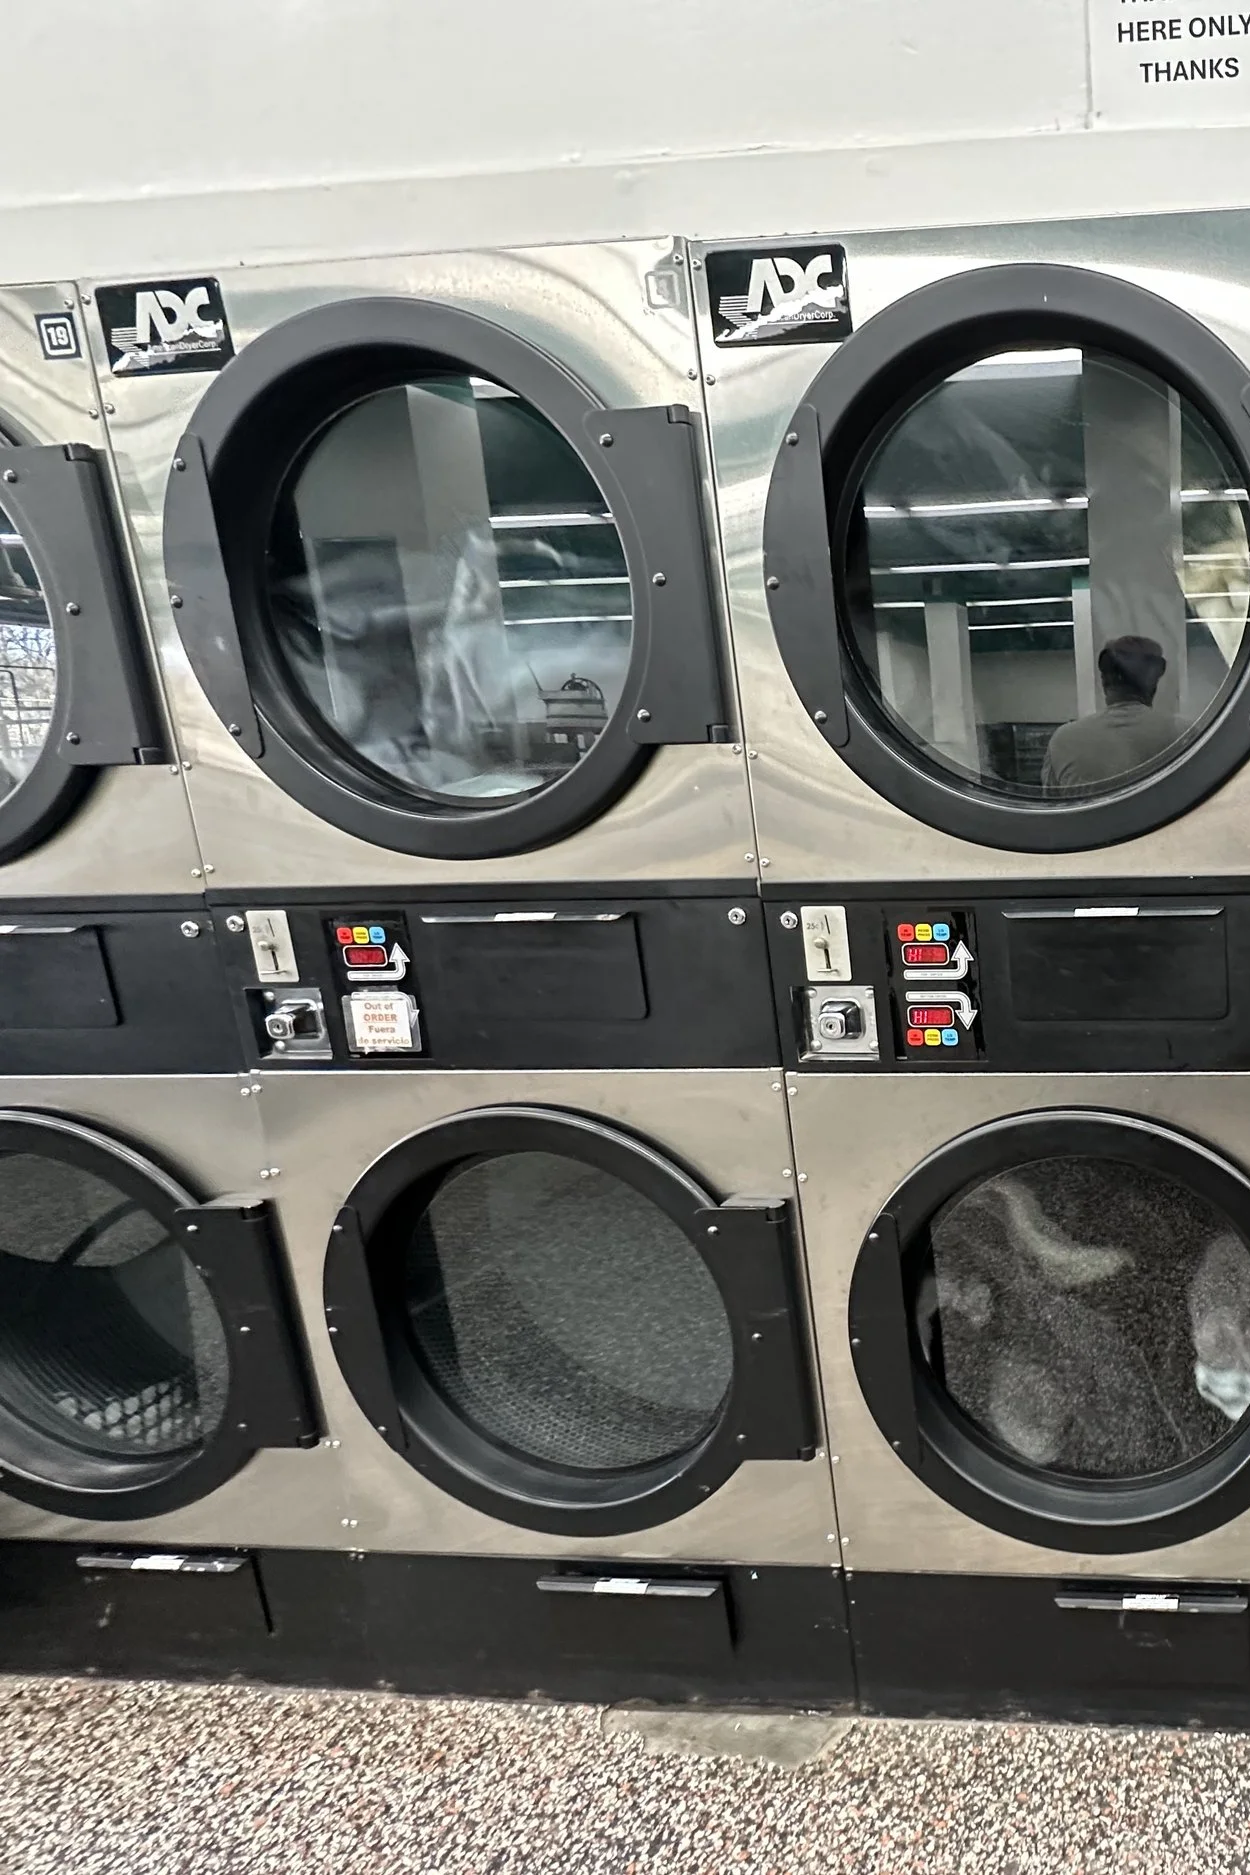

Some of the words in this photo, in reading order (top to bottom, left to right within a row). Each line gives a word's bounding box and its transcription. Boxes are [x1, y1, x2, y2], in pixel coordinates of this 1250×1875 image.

[1118, 18, 1182, 43] HERE
[1139, 57, 1240, 83] THANKS
[746, 253, 837, 313] ADC
[136, 286, 210, 344] ADC
[47, 326, 69, 346] 19
[364, 1002, 381, 1010] Out
[384, 1002, 394, 1010] of
[363, 1013, 398, 1022] ORDER
[368, 1025, 396, 1033] Fuera
[371, 1036, 410, 1045] servicio
